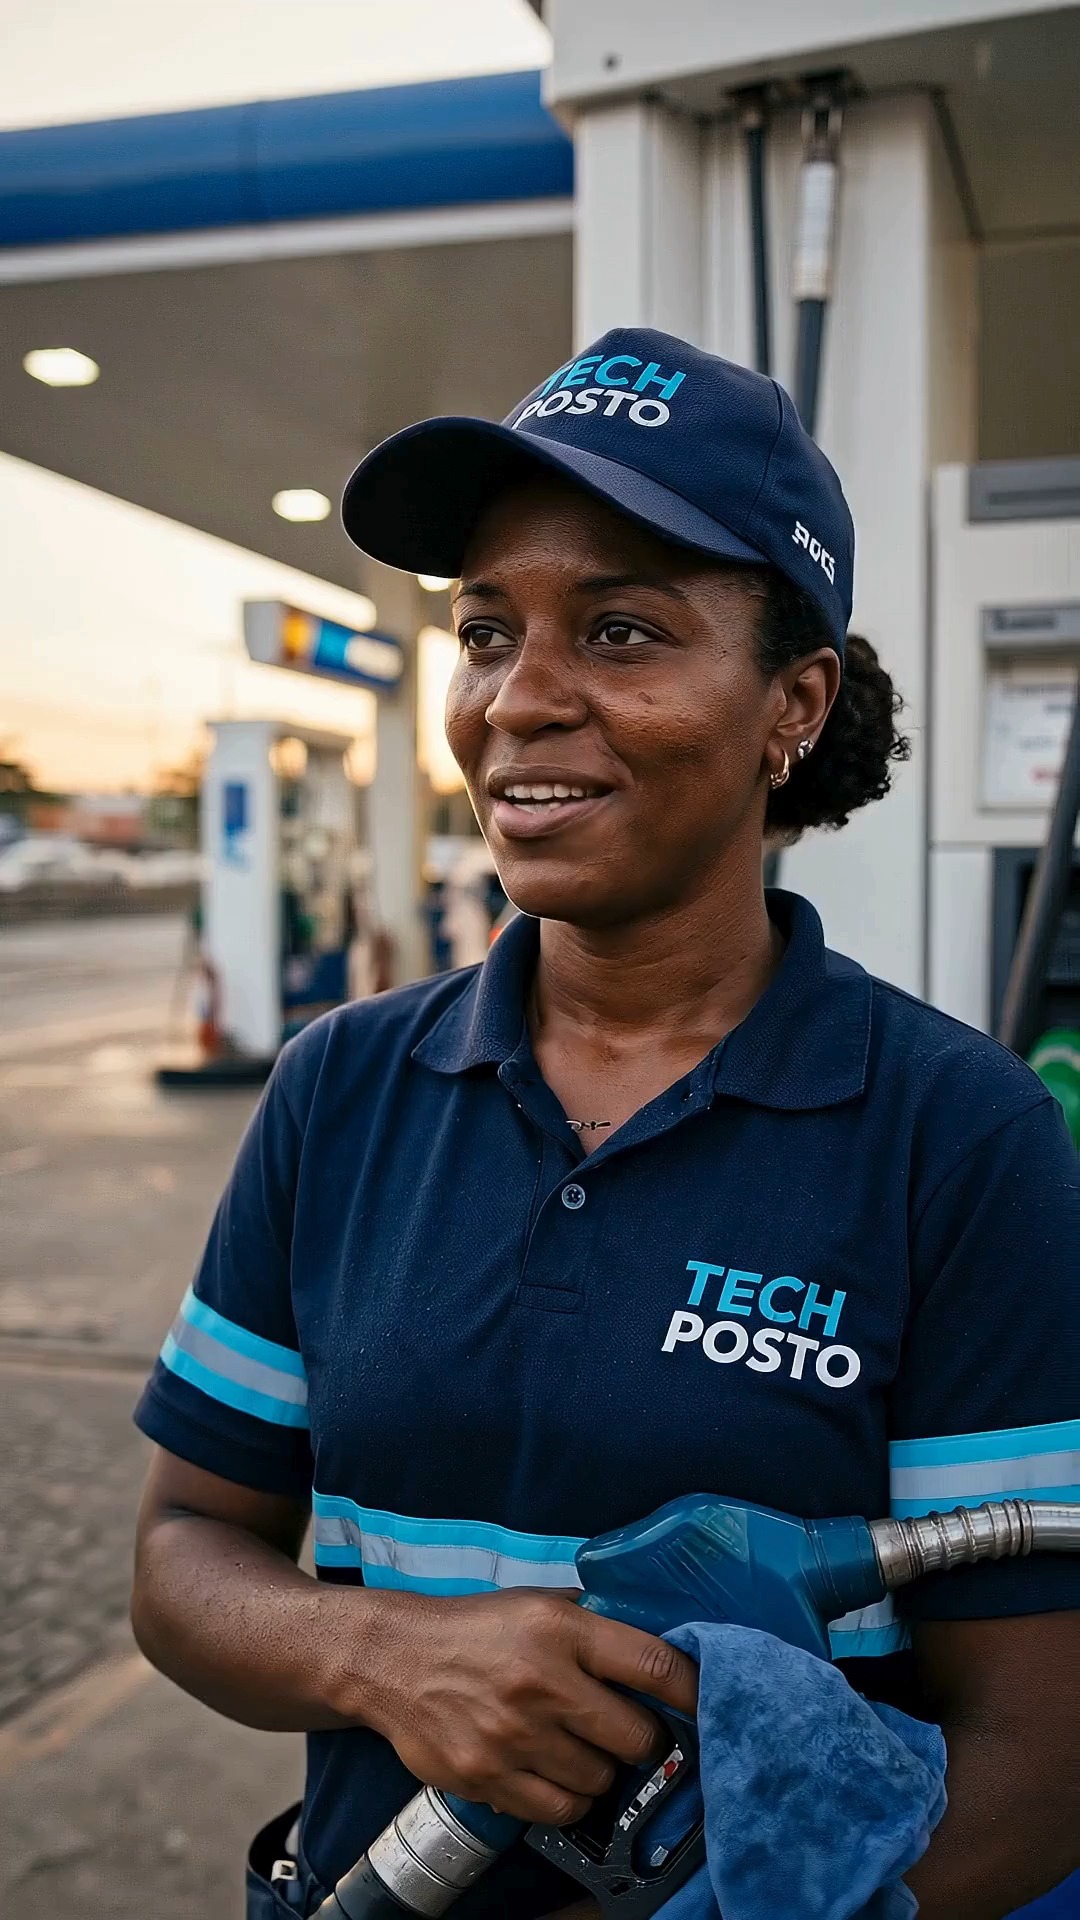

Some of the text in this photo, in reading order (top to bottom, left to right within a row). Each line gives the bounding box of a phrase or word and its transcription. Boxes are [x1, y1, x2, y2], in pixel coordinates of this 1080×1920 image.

[511, 387, 670, 428] POSTO
[537, 355, 687, 400] TECH
[686, 1260, 847, 1337] TECH
[661, 1310, 861, 1388] POSTO
